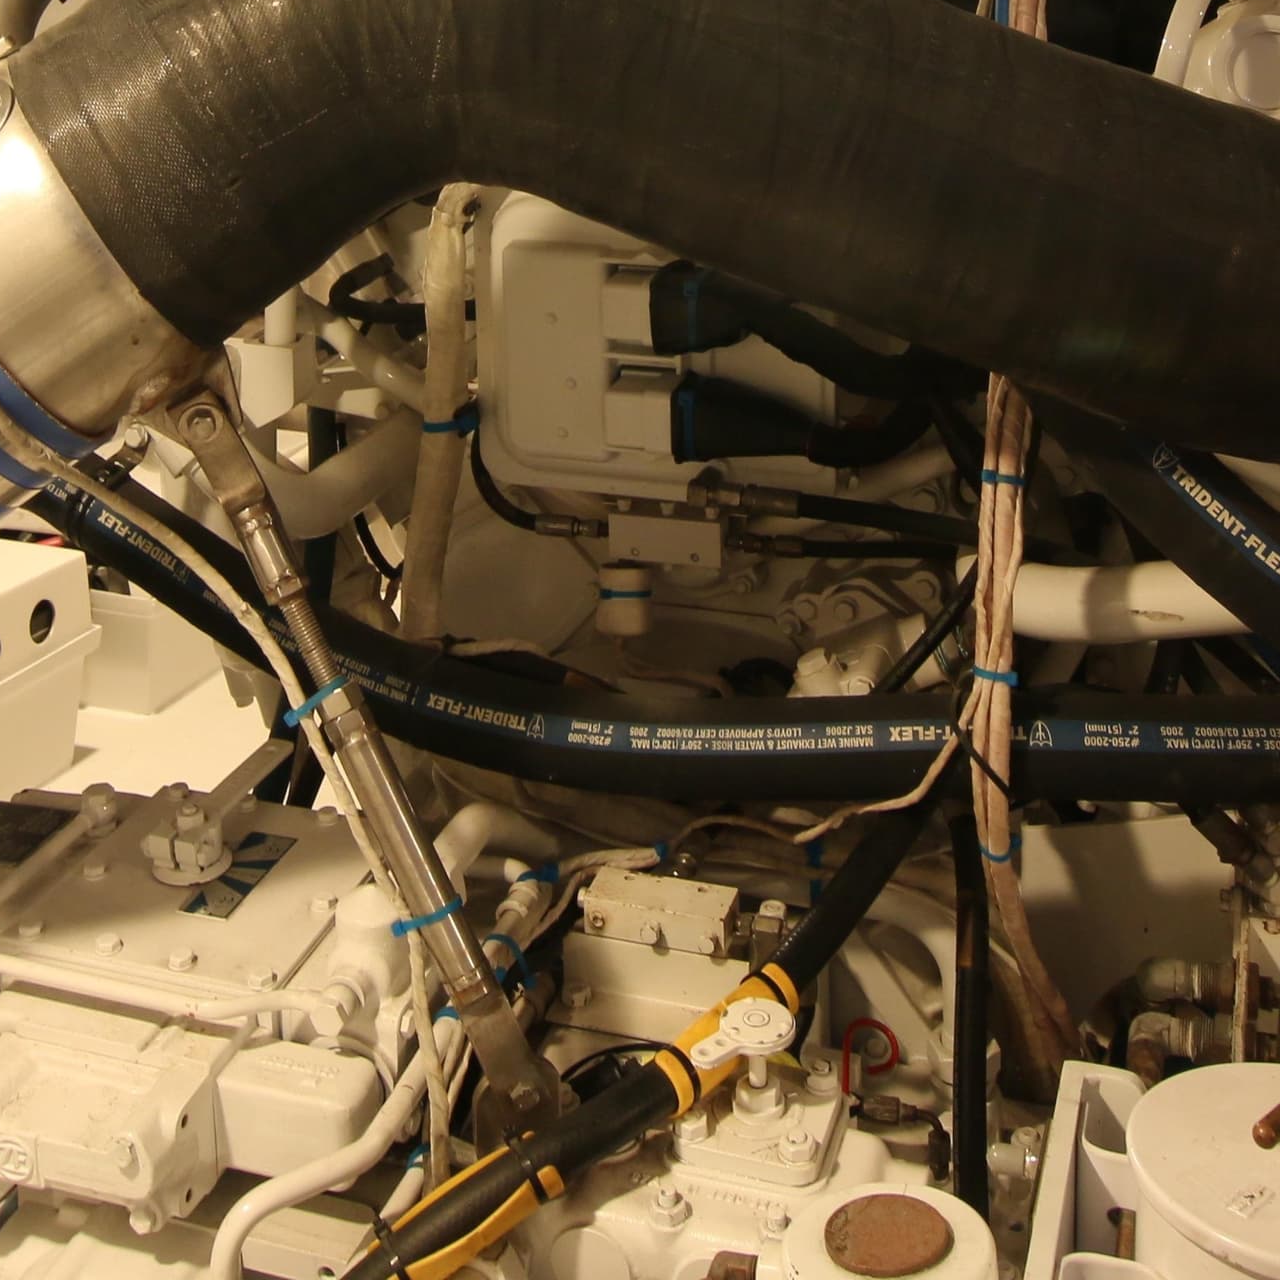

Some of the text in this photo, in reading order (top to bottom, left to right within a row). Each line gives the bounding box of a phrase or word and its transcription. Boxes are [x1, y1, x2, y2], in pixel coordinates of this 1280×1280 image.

[96, 509, 178, 572] TRIDENT-FLEX
[426, 692, 528, 732] TRIDENT-FLEX
[571, 719, 601, 734] (51mm)
[629, 725, 874, 738] SAE J2006 LLOYD'S APPROVED CERT 03/60002 2005
[1085, 722, 1122, 735] (51mm)
[1160, 725, 1267, 738] CERT 03/60002 2005
[567, 732, 612, 747] #250-2000
[735, 740, 765, 750] WATER
[766, 740, 775, 750] &
[775, 739, 815, 750] EXHAUST
[817, 738, 836, 749] WET
[836, 737, 874, 748] MARINE
[1084, 736, 1140, 748] #250-2000
[1191, 739, 1225, 750] (120°C)
[1227, 740, 1253, 750] 250°F
[711, 740, 734, 751] HOSE
